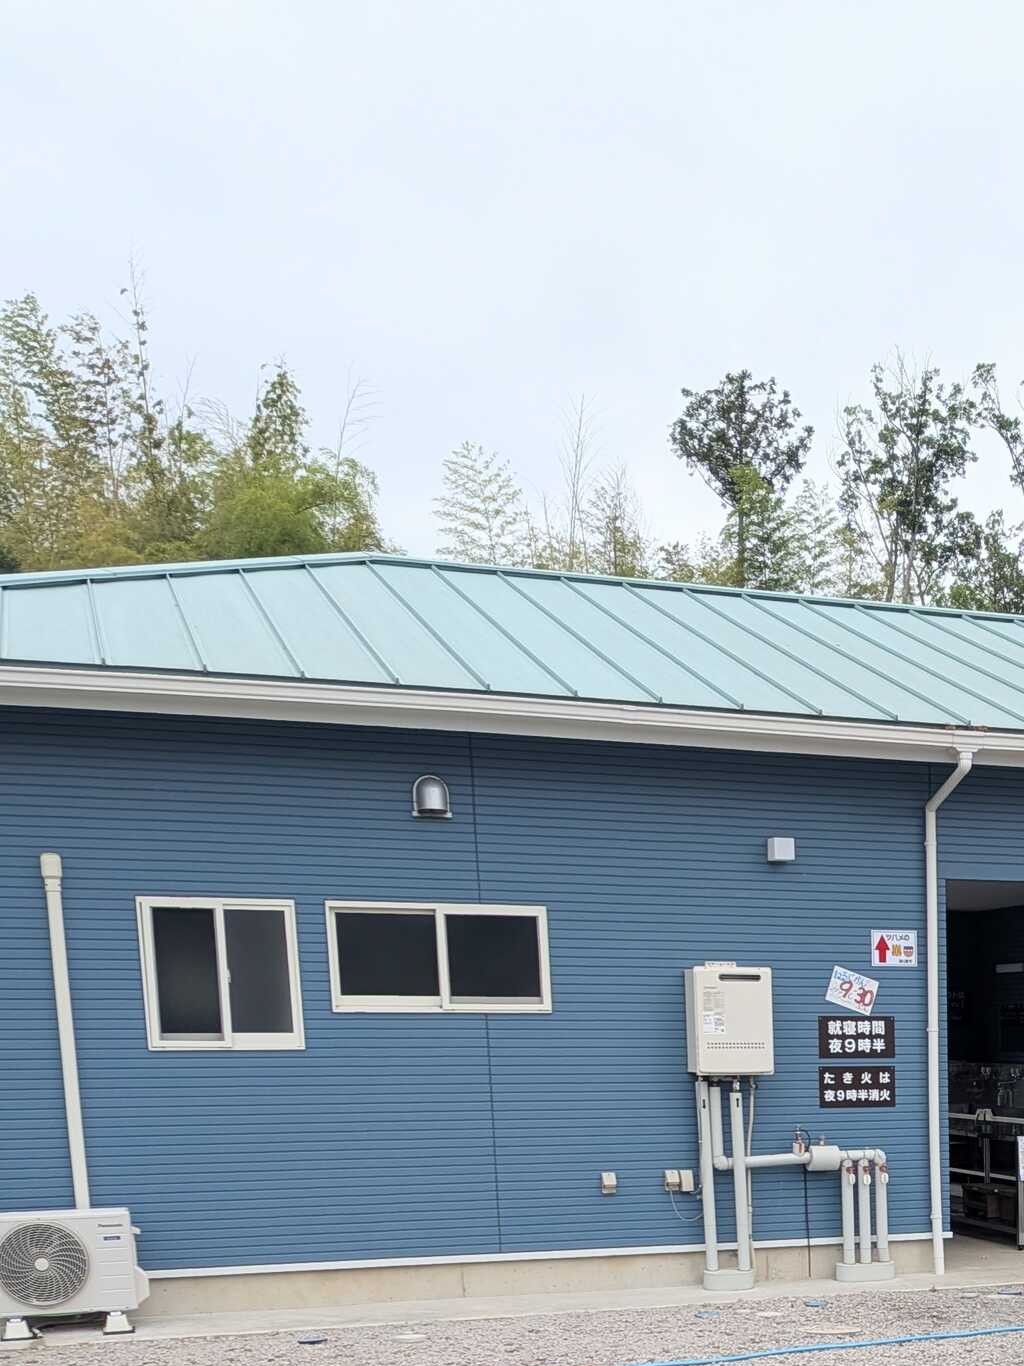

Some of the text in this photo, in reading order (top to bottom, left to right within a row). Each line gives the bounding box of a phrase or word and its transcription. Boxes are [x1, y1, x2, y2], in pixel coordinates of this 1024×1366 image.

[827, 1020, 886, 1035] 就寝時間
[828, 1038, 886, 1053] 夜9時半
[823, 1071, 891, 1084] たき火は
[823, 1088, 891, 1102] 夜9時半消火
